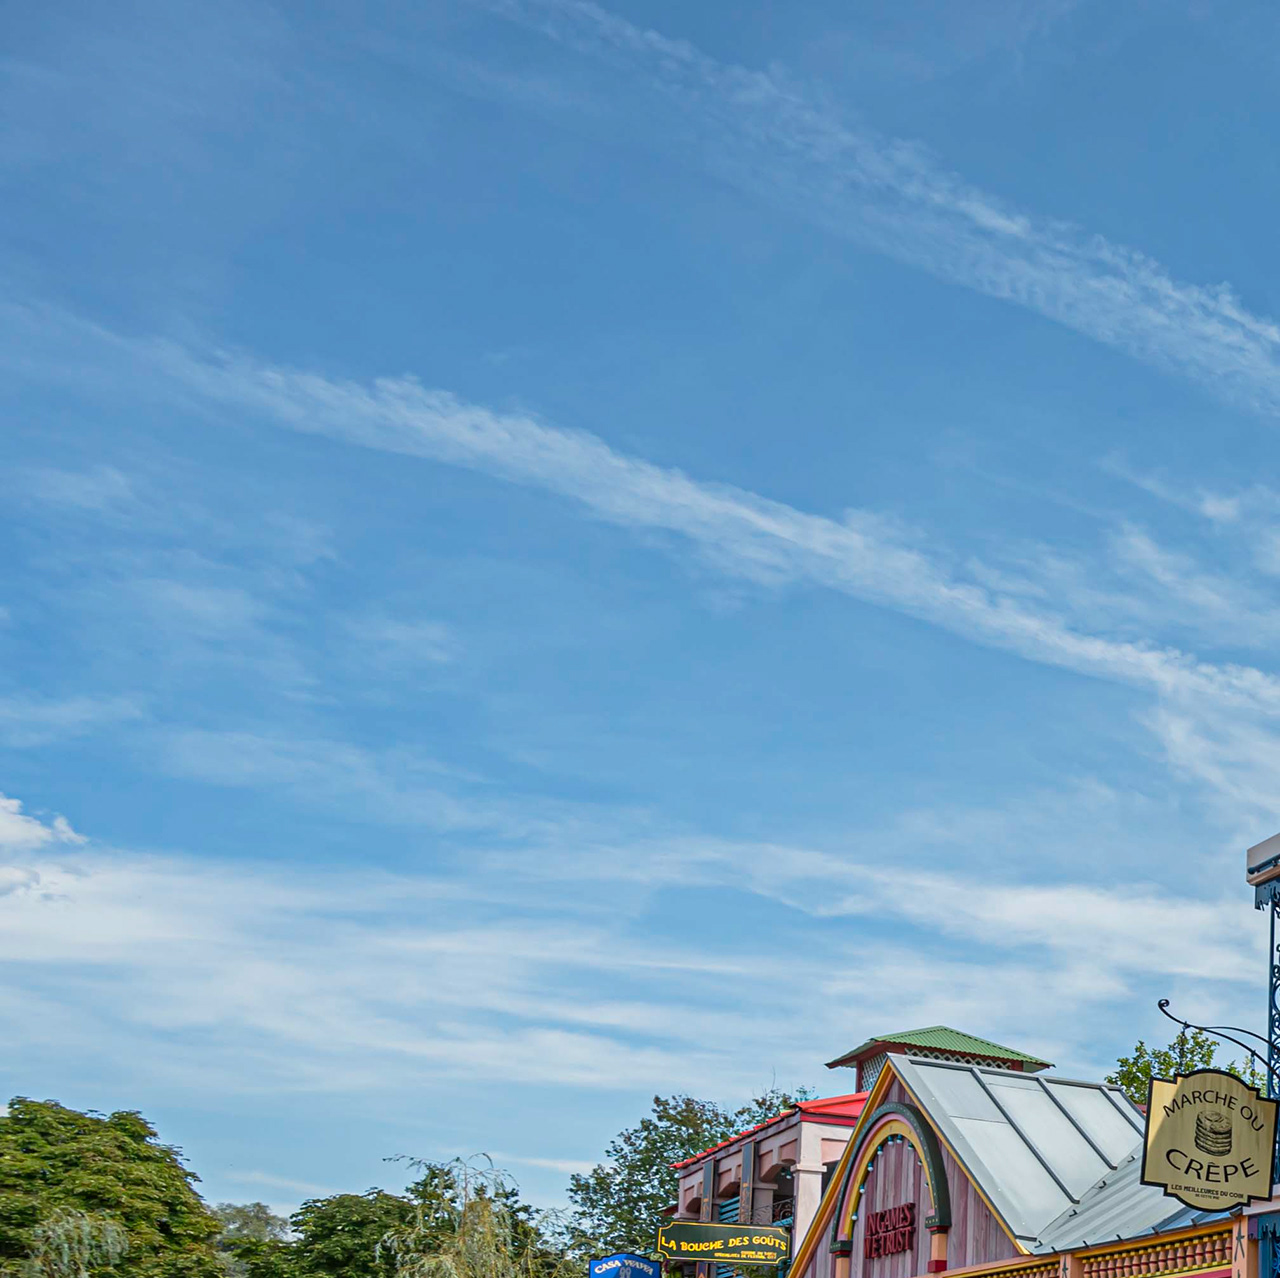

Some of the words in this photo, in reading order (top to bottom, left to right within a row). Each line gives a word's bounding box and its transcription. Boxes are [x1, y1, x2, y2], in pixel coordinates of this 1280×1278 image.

[1163, 1090, 1238, 1118] MARCHE
[1240, 1105, 1265, 1132] OU
[1165, 1148, 1260, 1183] CRÊPE
[1184, 1186, 1219, 1196] MEILLEURES
[865, 1212, 877, 1236] IN
[877, 1202, 916, 1234] GAMES
[661, 1236, 677, 1251] LA
[680, 1239, 724, 1252] BOUCHE
[728, 1236, 749, 1249] DES
[752, 1234, 787, 1251] GOÛTS
[864, 1235, 881, 1260] WE
[880, 1226, 917, 1257] TRUST
[594, 1260, 622, 1274] CASA
